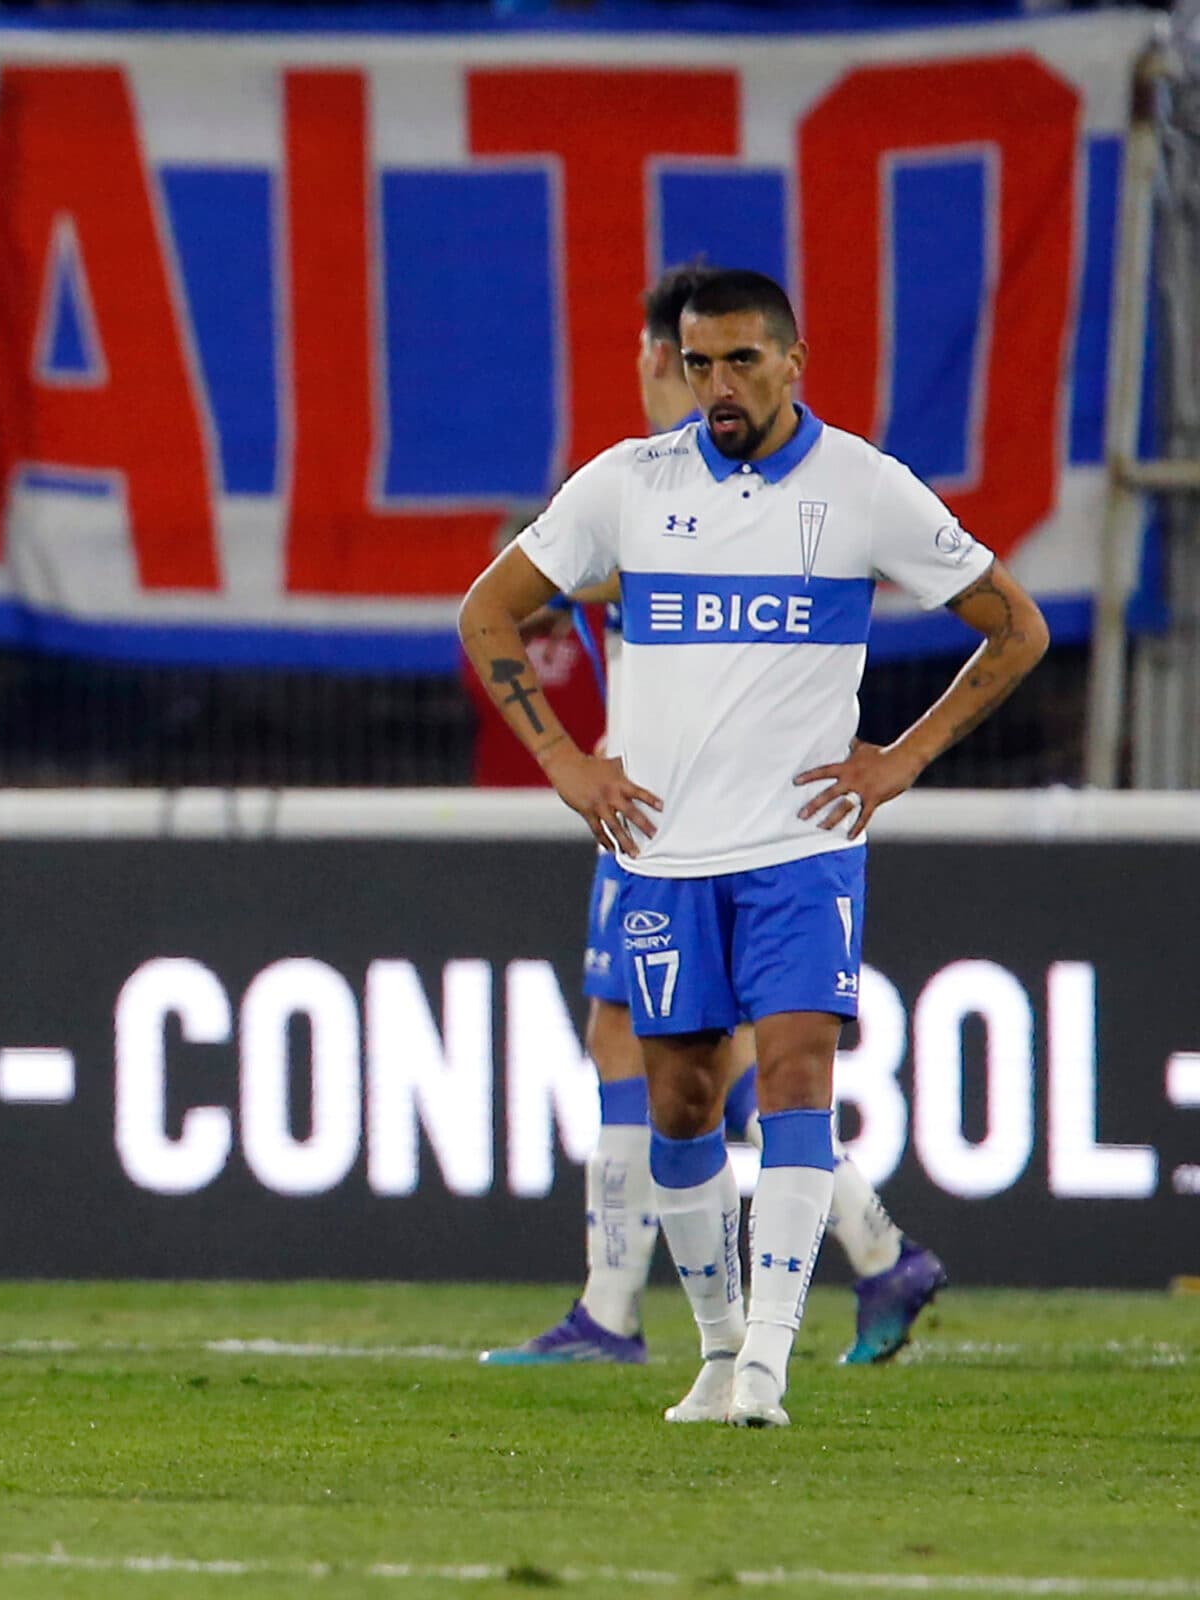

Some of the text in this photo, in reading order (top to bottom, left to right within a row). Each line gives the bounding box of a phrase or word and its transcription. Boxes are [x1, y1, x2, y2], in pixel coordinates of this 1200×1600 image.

[696, 593, 813, 633] BICE
[634, 949, 680, 1018] 17
[115, 957, 1158, 1198] CONMBOL
